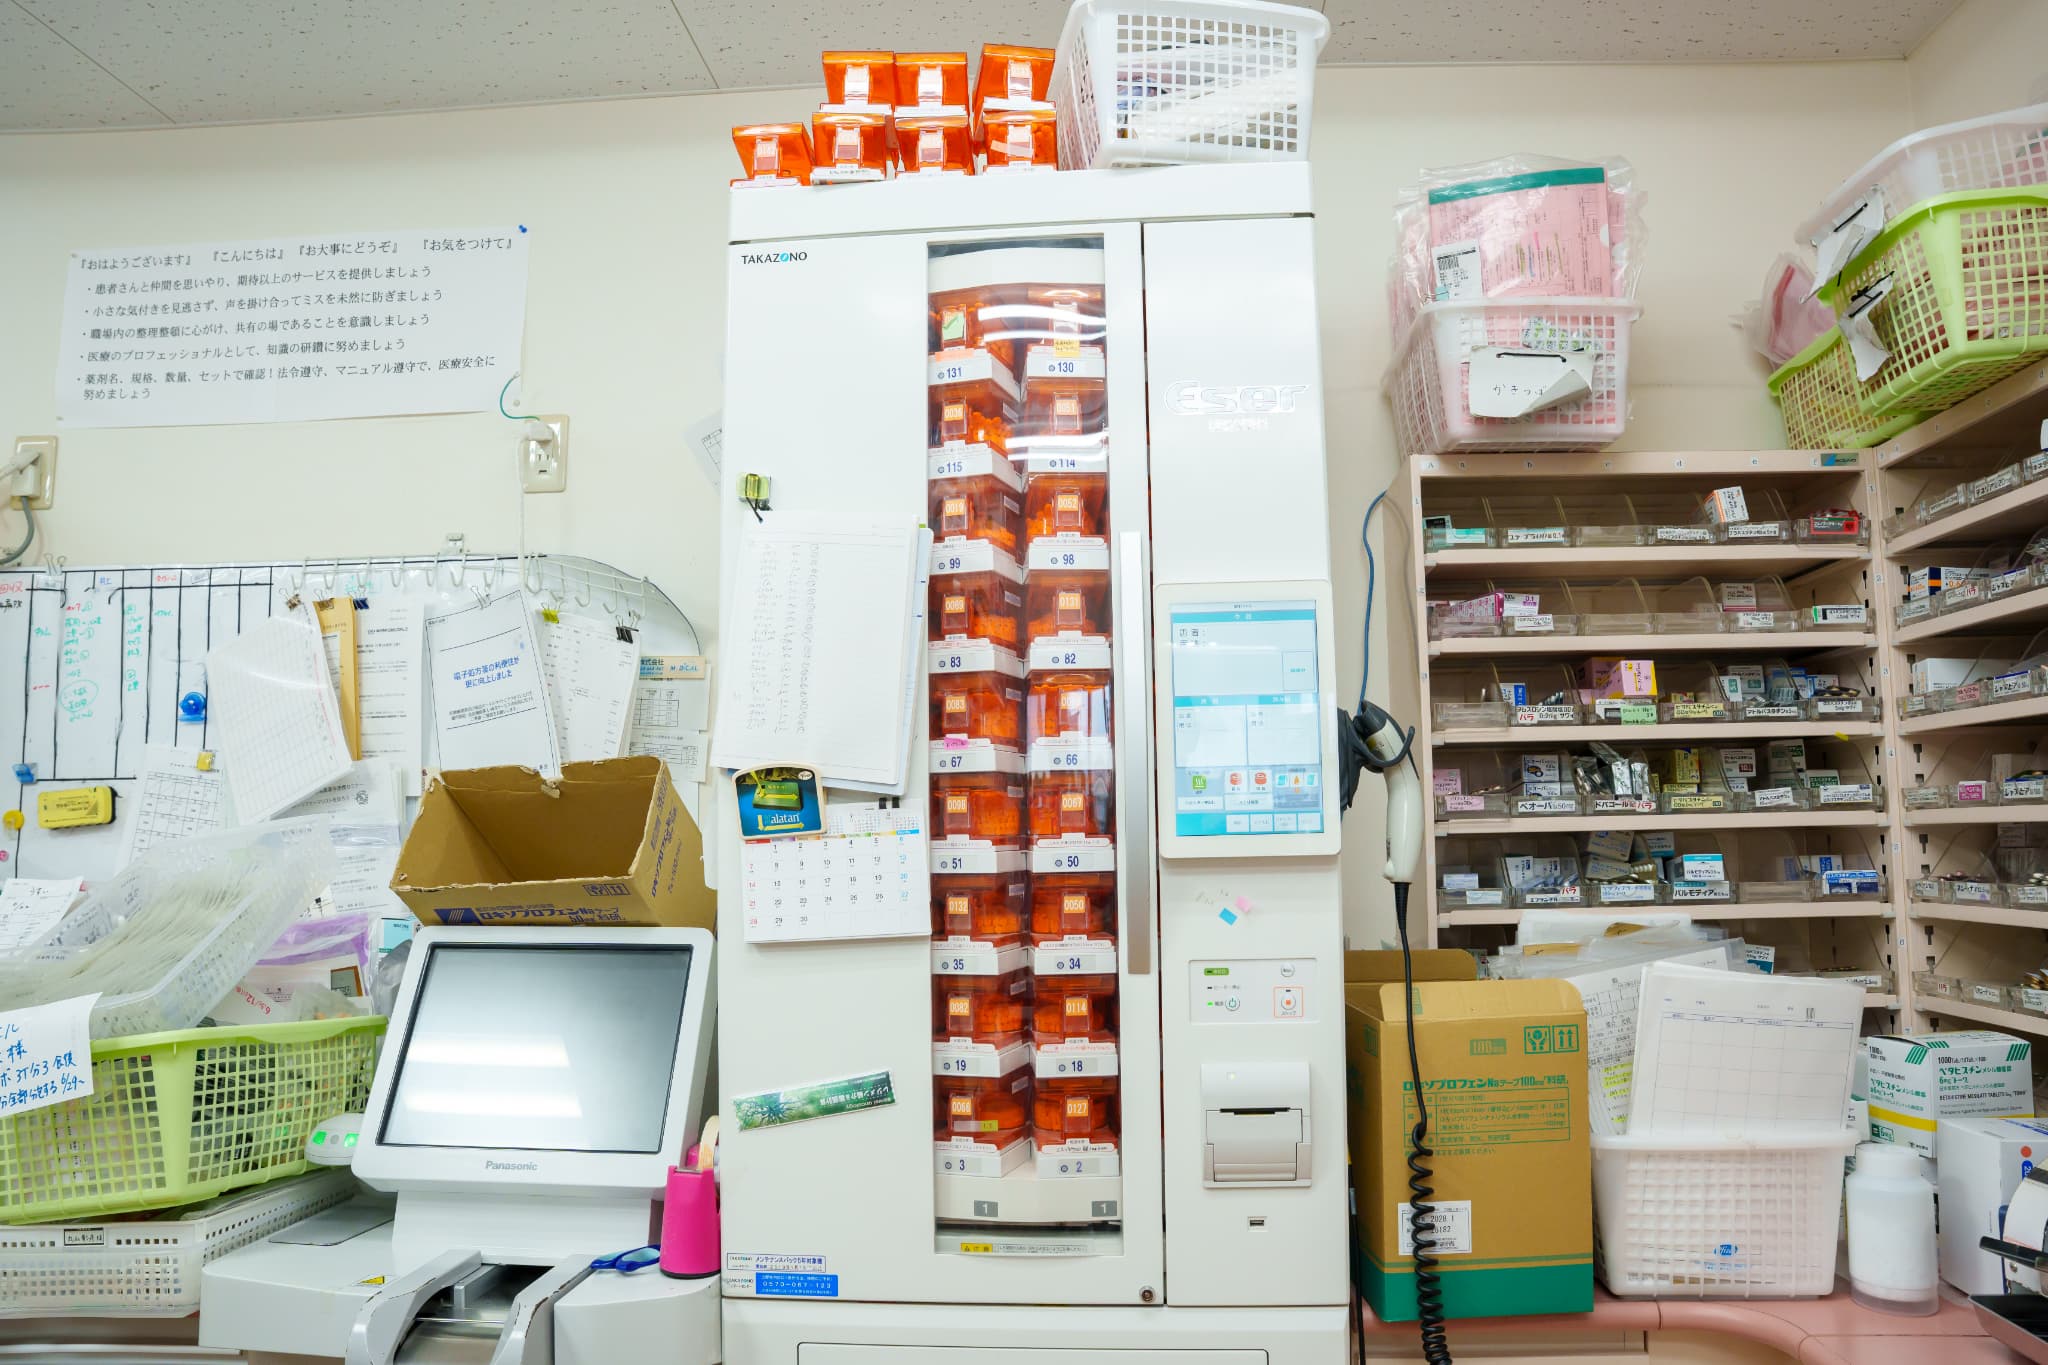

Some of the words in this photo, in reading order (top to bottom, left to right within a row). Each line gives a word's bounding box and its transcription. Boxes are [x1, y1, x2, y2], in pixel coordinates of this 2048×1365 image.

[80, 254, 192, 270] 『おはようございます』
[212, 248, 284, 263] 『こんにちは』
[299, 240, 399, 256] 『お大事にどうぞ』
[423, 237, 513, 251] 『お気をつけて』
[741, 251, 808, 264] TAKAZONO
[946, 366, 963, 379] 131
[1057, 361, 1074, 373] 130
[83, 387, 151, 400] 努めましょう
[946, 461, 963, 473] 115
[1059, 458, 1076, 468] 114
[949, 558, 961, 569] 99
[1062, 554, 1075, 566] 98
[950, 656, 962, 668] 83
[1064, 653, 1076, 664] 82
[951, 756, 962, 768] 67
[1066, 754, 1078, 766] 66
[952, 857, 962, 869] 51
[1067, 855, 1079, 867] 50
[949, 899, 968, 912] 0132
[953, 959, 964, 970] 35
[1069, 958, 1081, 970] 34
[1066, 1001, 1087, 1014] 0114
[956, 1060, 966, 1072] 19
[1072, 1060, 1083, 1073] 18
[1068, 1103, 1087, 1114] 0127
[485, 1160, 538, 1171] Panasonic
[959, 1159, 965, 1171] 3
[1076, 1161, 1082, 1172] 2
[983, 1203, 989, 1214] 1
[1101, 1203, 1107, 1214] 1
